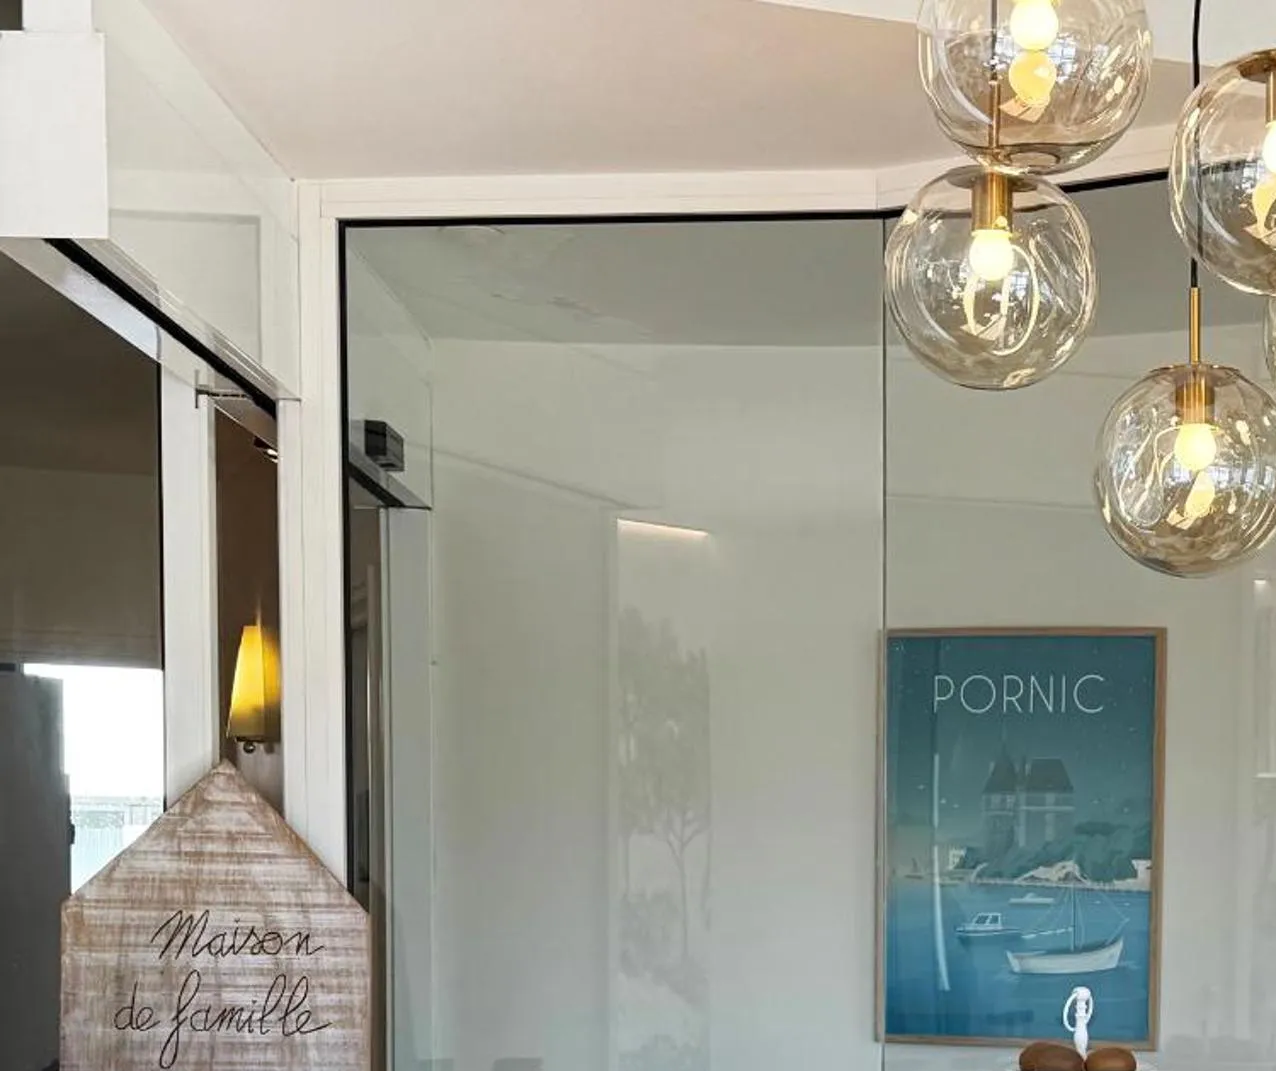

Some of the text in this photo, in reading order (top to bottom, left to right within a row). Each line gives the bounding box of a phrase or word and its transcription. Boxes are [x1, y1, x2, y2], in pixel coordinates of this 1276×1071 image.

[932, 674, 1105, 714] PORNIC
[150, 909, 325, 960] Maison
[113, 969, 334, 1070] de famille
